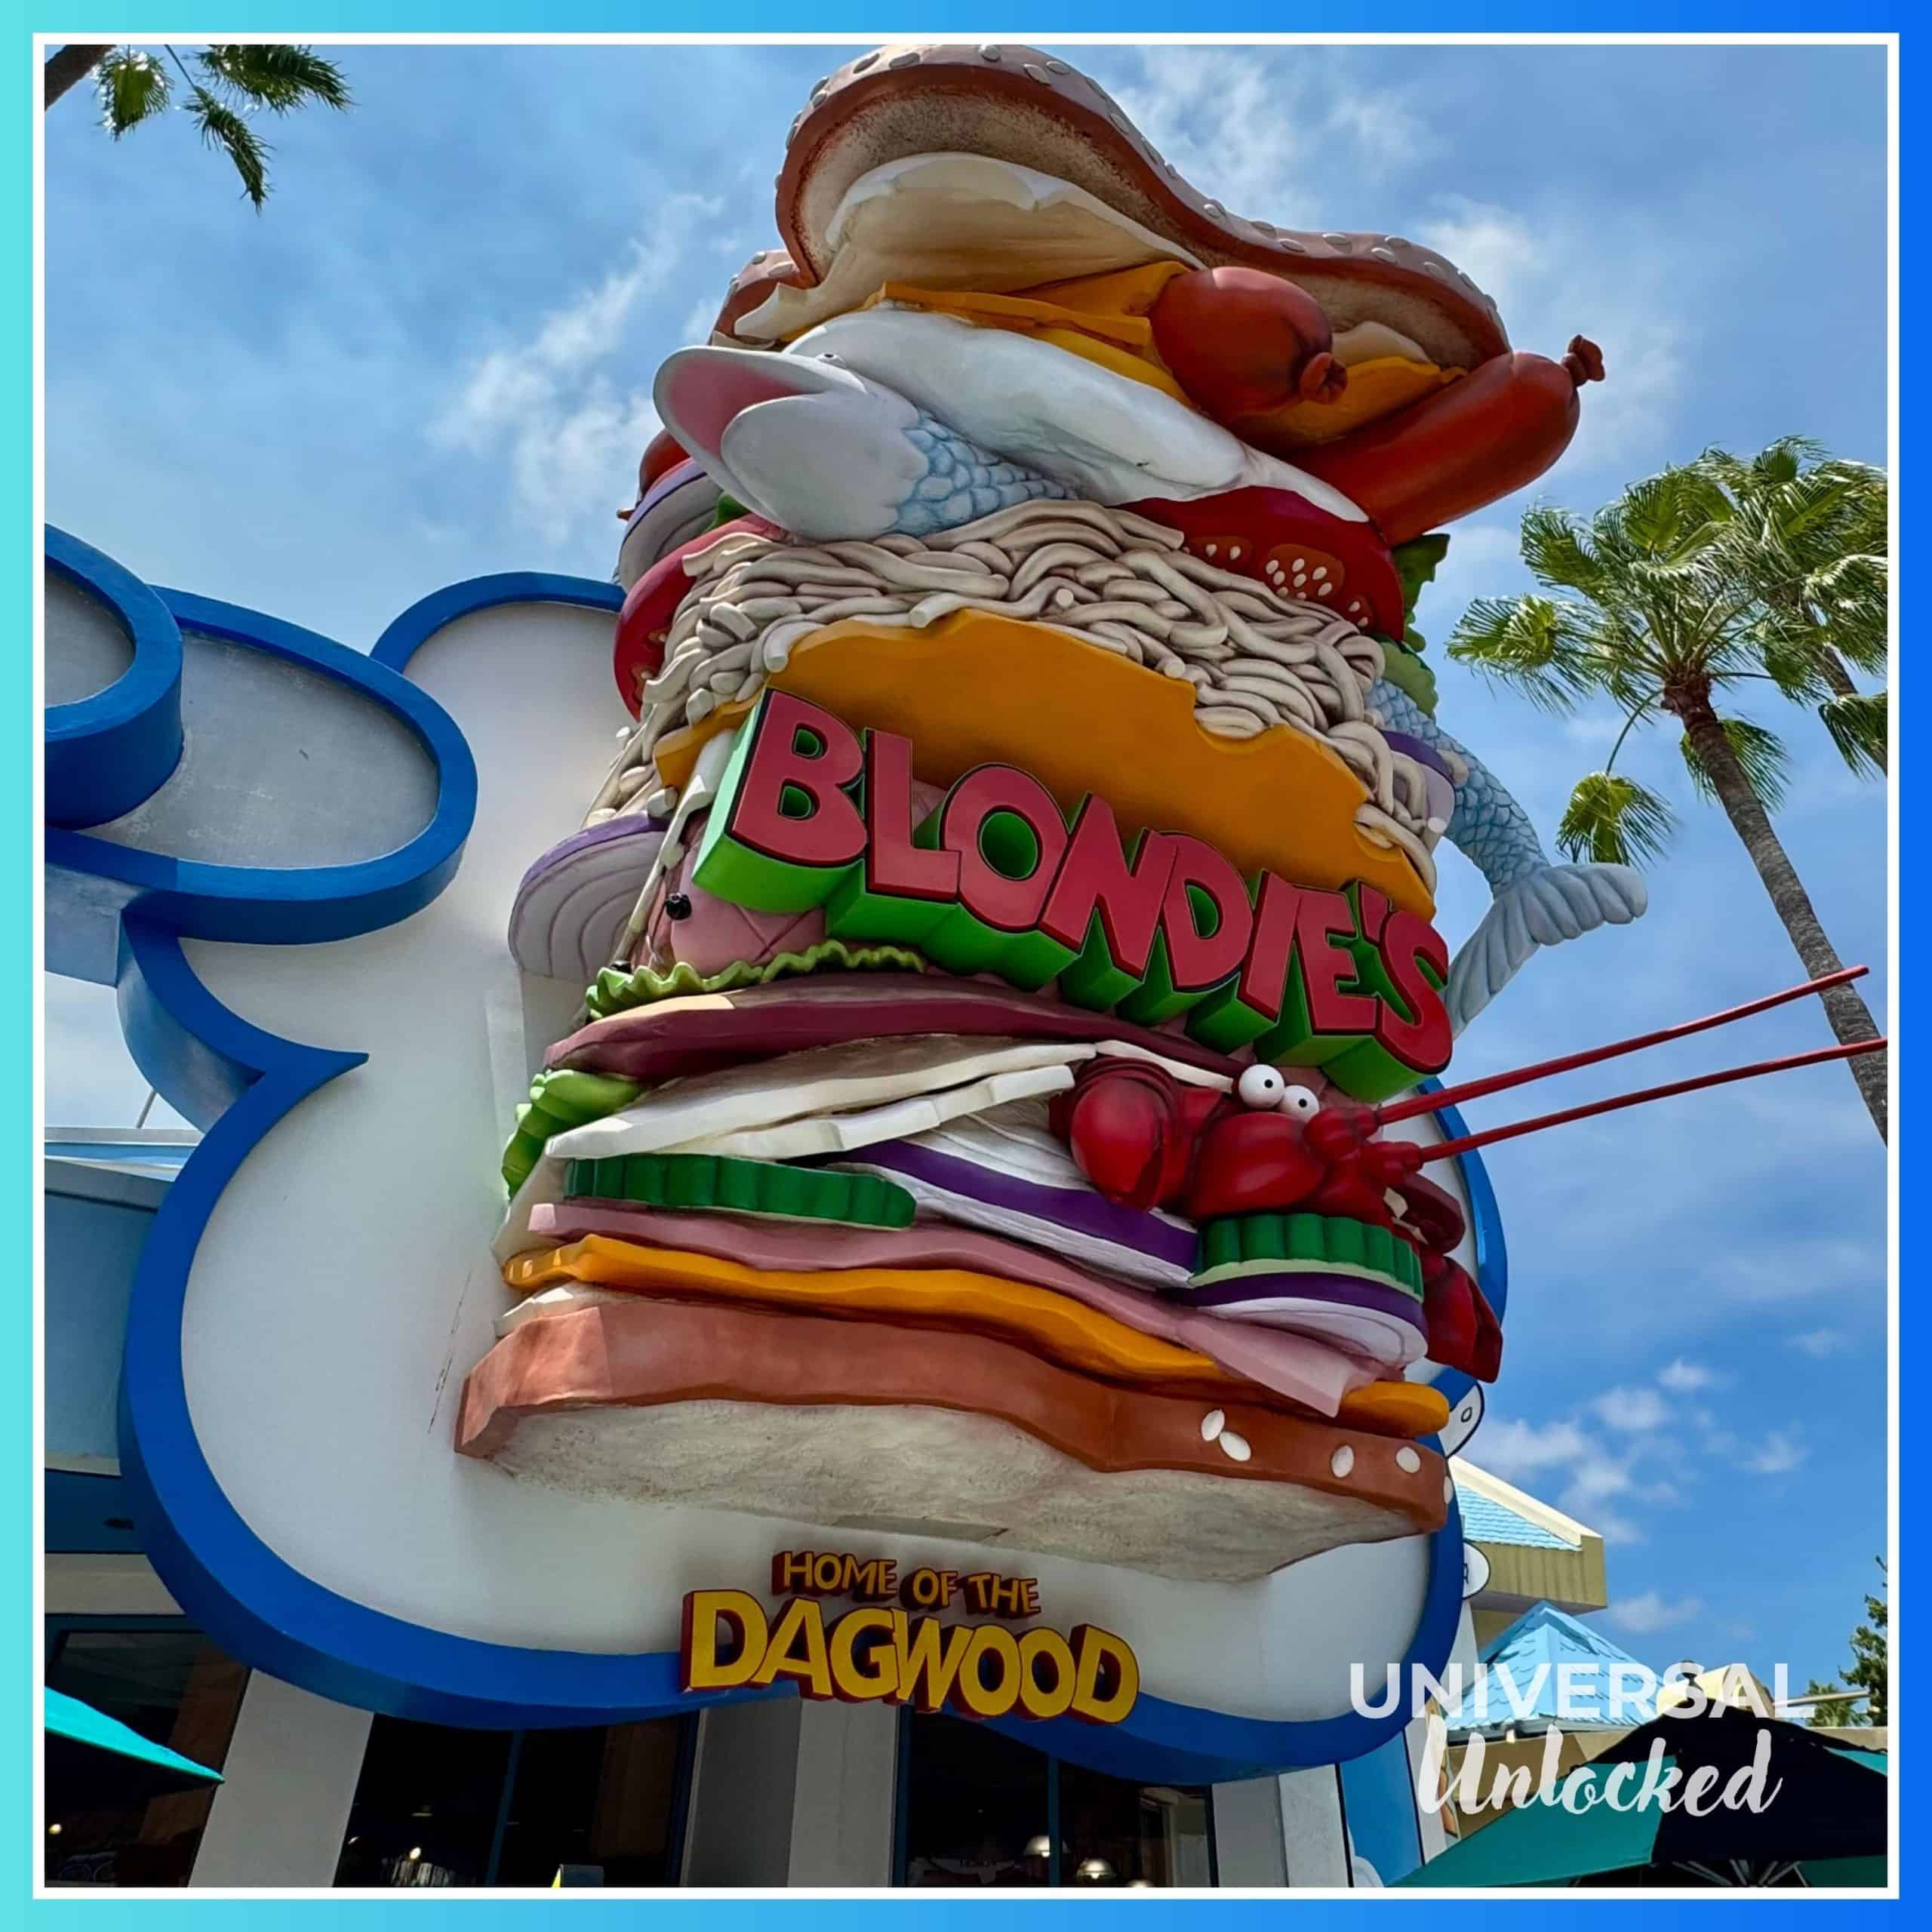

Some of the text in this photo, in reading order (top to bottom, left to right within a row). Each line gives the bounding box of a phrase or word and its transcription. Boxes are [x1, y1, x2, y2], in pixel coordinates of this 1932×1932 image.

[729, 687, 1454, 1075] BLONDIE'S
[780, 1550, 1041, 1614] HOME OF THE
[687, 1589, 1140, 1724] DAGWOOD
